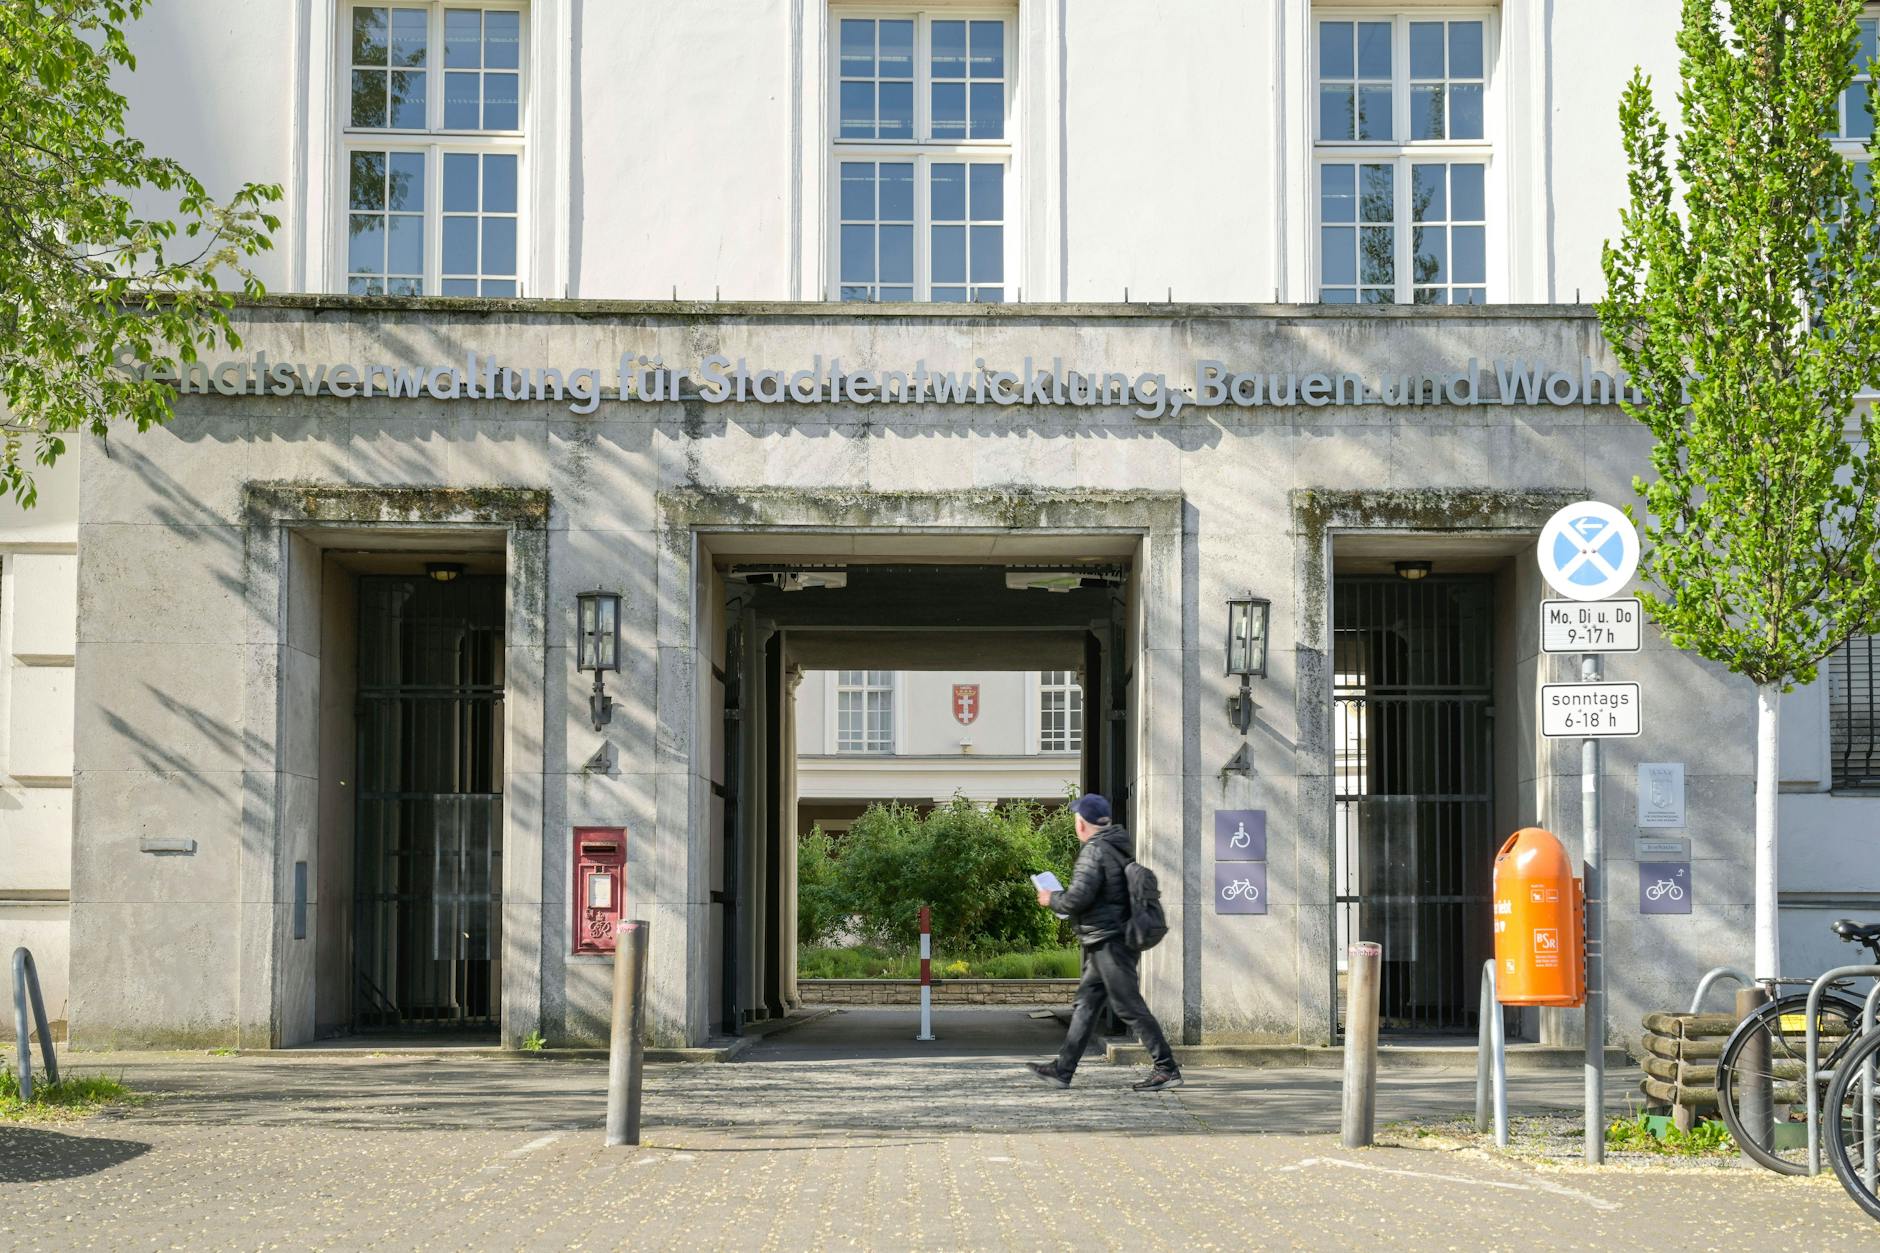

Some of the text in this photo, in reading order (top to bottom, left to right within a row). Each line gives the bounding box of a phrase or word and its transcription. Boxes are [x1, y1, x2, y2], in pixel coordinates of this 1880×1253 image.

[617, 352, 687, 402] für
[698, 354, 1184, 419] Stadtentwicklung,
[1196, 359, 1363, 407] Bauen
[1382, 358, 1478, 407] und
[1579, 608, 1591, 624] Di
[1598, 611, 1609, 624] u.
[1616, 608, 1632, 623] Do
[1552, 693, 1629, 709] sonntags
[1564, 712, 1616, 727] 6-18 h
[583, 739, 611, 774] 4
[1222, 742, 1250, 776] 4
[1536, 933, 1556, 949] BSR
